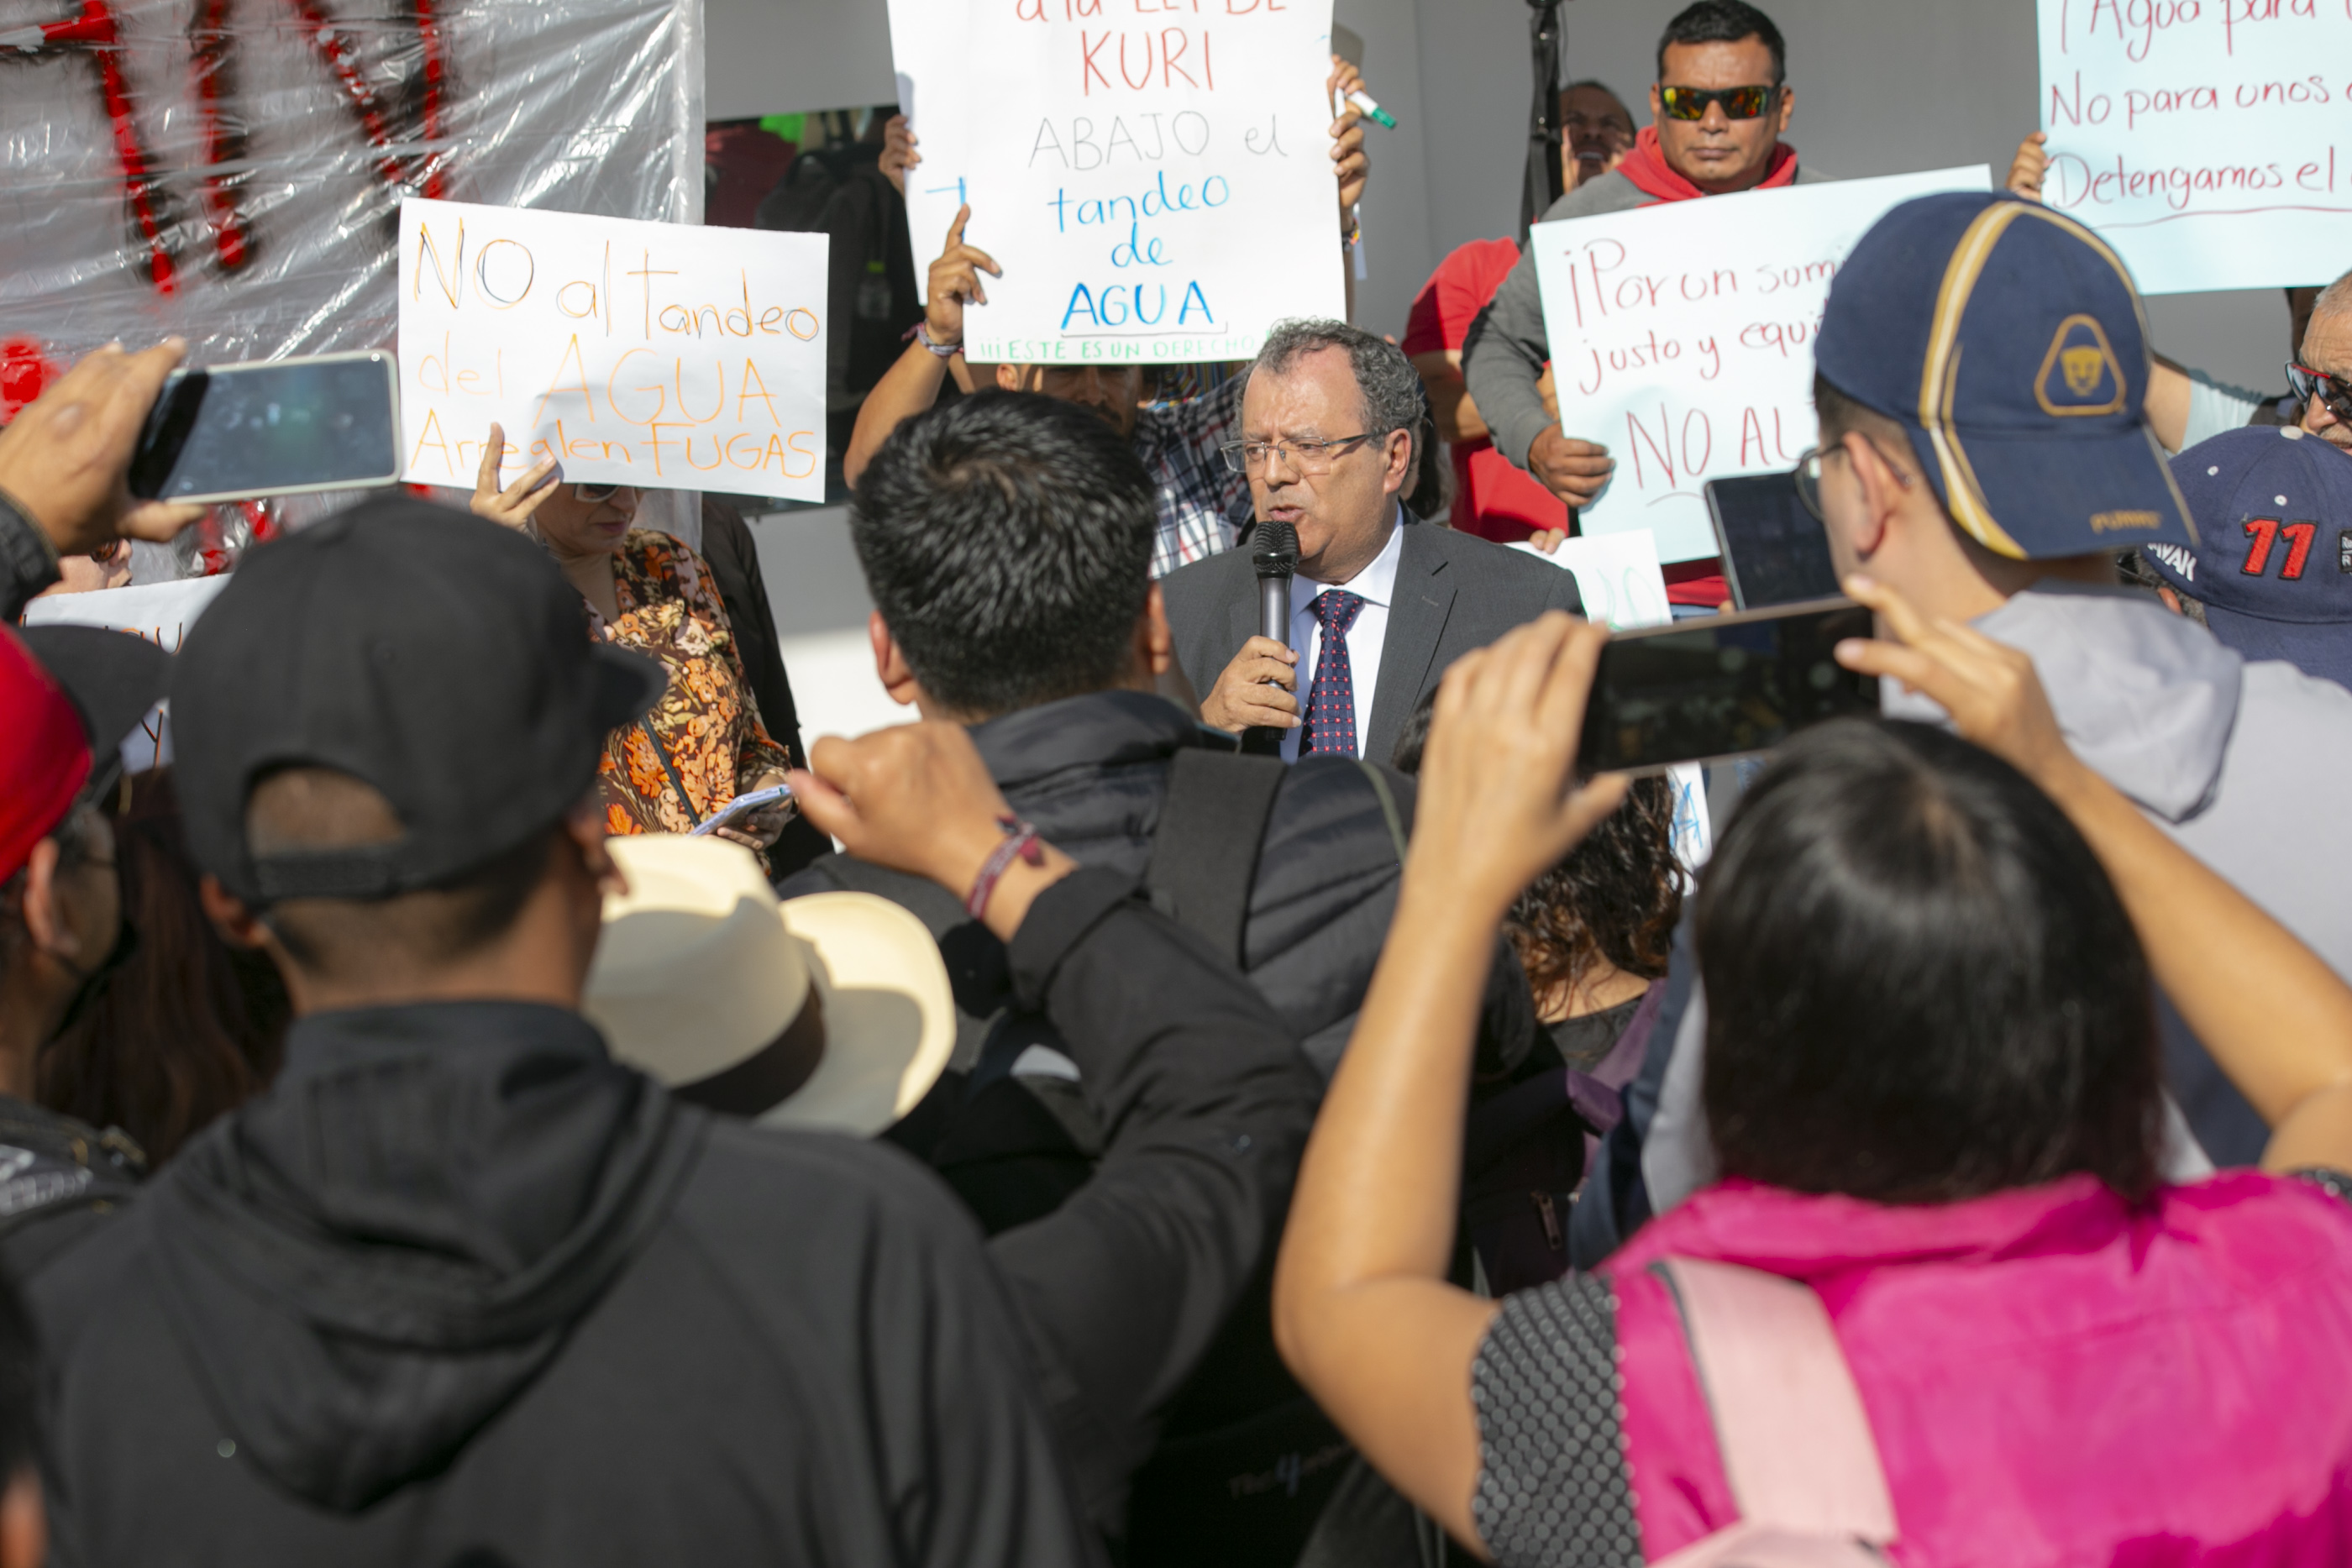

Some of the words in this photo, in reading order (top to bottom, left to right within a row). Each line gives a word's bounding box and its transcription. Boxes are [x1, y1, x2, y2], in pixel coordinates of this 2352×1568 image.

[1080, 27, 1215, 97] KURI
[2050, 69, 2112, 127] No
[2124, 85, 2218, 131] para
[2235, 75, 2330, 108] unos
[1028, 110, 1210, 170] ABAJO
[1244, 113, 1289, 158] el
[1047, 170, 1231, 234] tandeo
[2048, 151, 2283, 211] Detengamos
[2295, 144, 2335, 193] el
[1110, 221, 1174, 269] de
[1680, 269, 1738, 301] un
[1756, 245, 1847, 294] sum
[415, 217, 536, 310] NO
[556, 239, 613, 338] al
[1060, 279, 1215, 331] AGUA
[1081, 340, 1102, 359] ES
[1110, 340, 1141, 359] UN
[1578, 329, 1681, 396] justo
[1698, 335, 1721, 380] y
[1739, 296, 1829, 359] equi
[417, 330, 503, 399] del
[531, 333, 782, 430] AGUA
[640, 421, 817, 480] FUGAS
[1626, 401, 1712, 490] NO
[2240, 515, 2318, 581] 11
